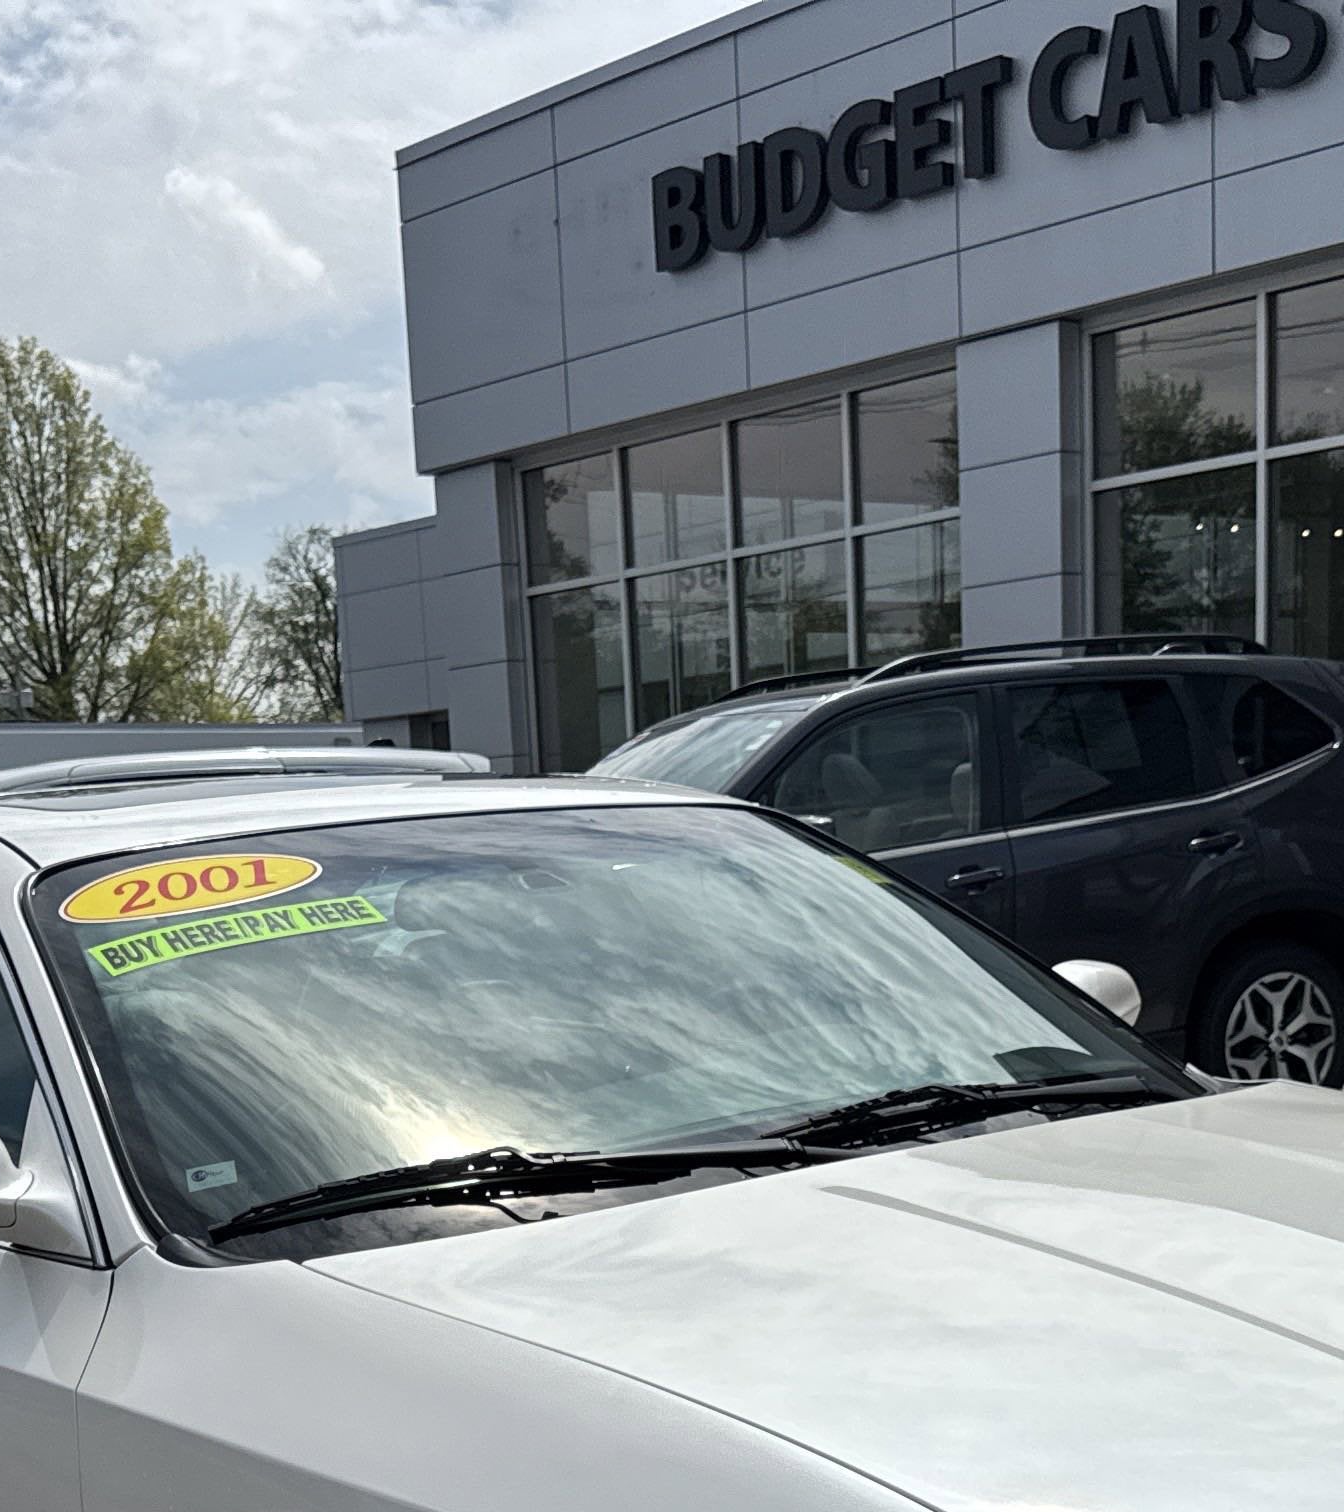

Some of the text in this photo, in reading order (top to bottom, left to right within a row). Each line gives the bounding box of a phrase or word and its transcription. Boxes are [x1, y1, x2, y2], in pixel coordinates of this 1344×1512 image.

[652, 0, 1328, 272] BUDGET CARS
[114, 860, 277, 914] 2001
[101, 900, 376, 970] BUY HERE/PAY HERE
